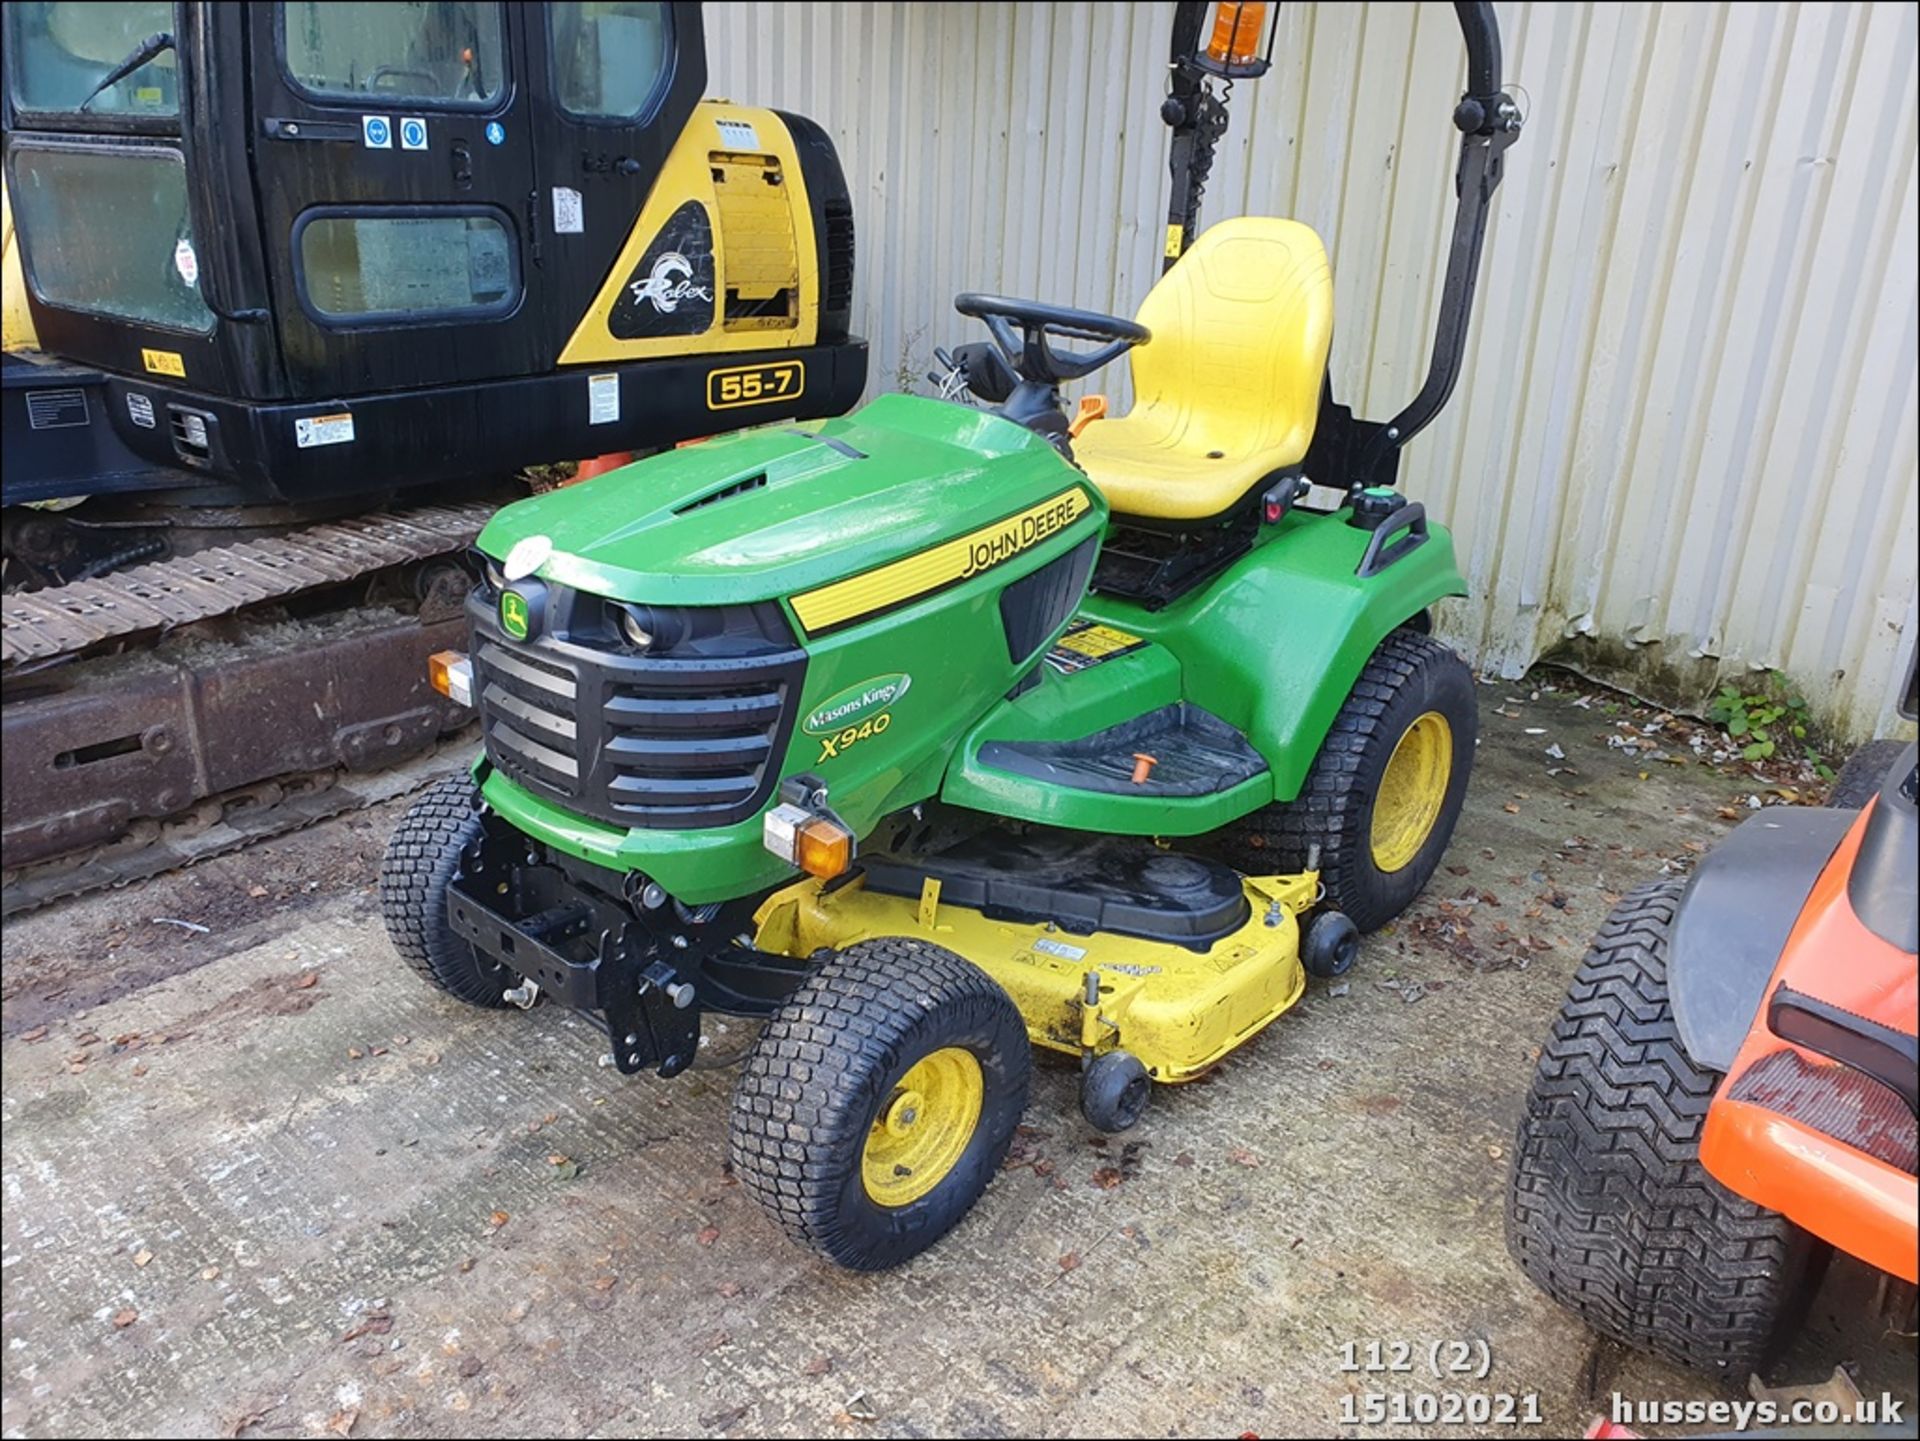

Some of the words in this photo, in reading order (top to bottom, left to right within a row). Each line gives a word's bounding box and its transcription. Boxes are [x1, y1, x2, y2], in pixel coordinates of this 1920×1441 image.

[630, 265, 713, 312] Robex
[720, 369, 793, 400] 55-7
[963, 529, 1017, 575] JOHN
[1021, 498, 1075, 544] DEERE
[809, 698, 862, 730] Masons
[862, 682, 896, 705] Kings
[816, 713, 890, 764] X940
